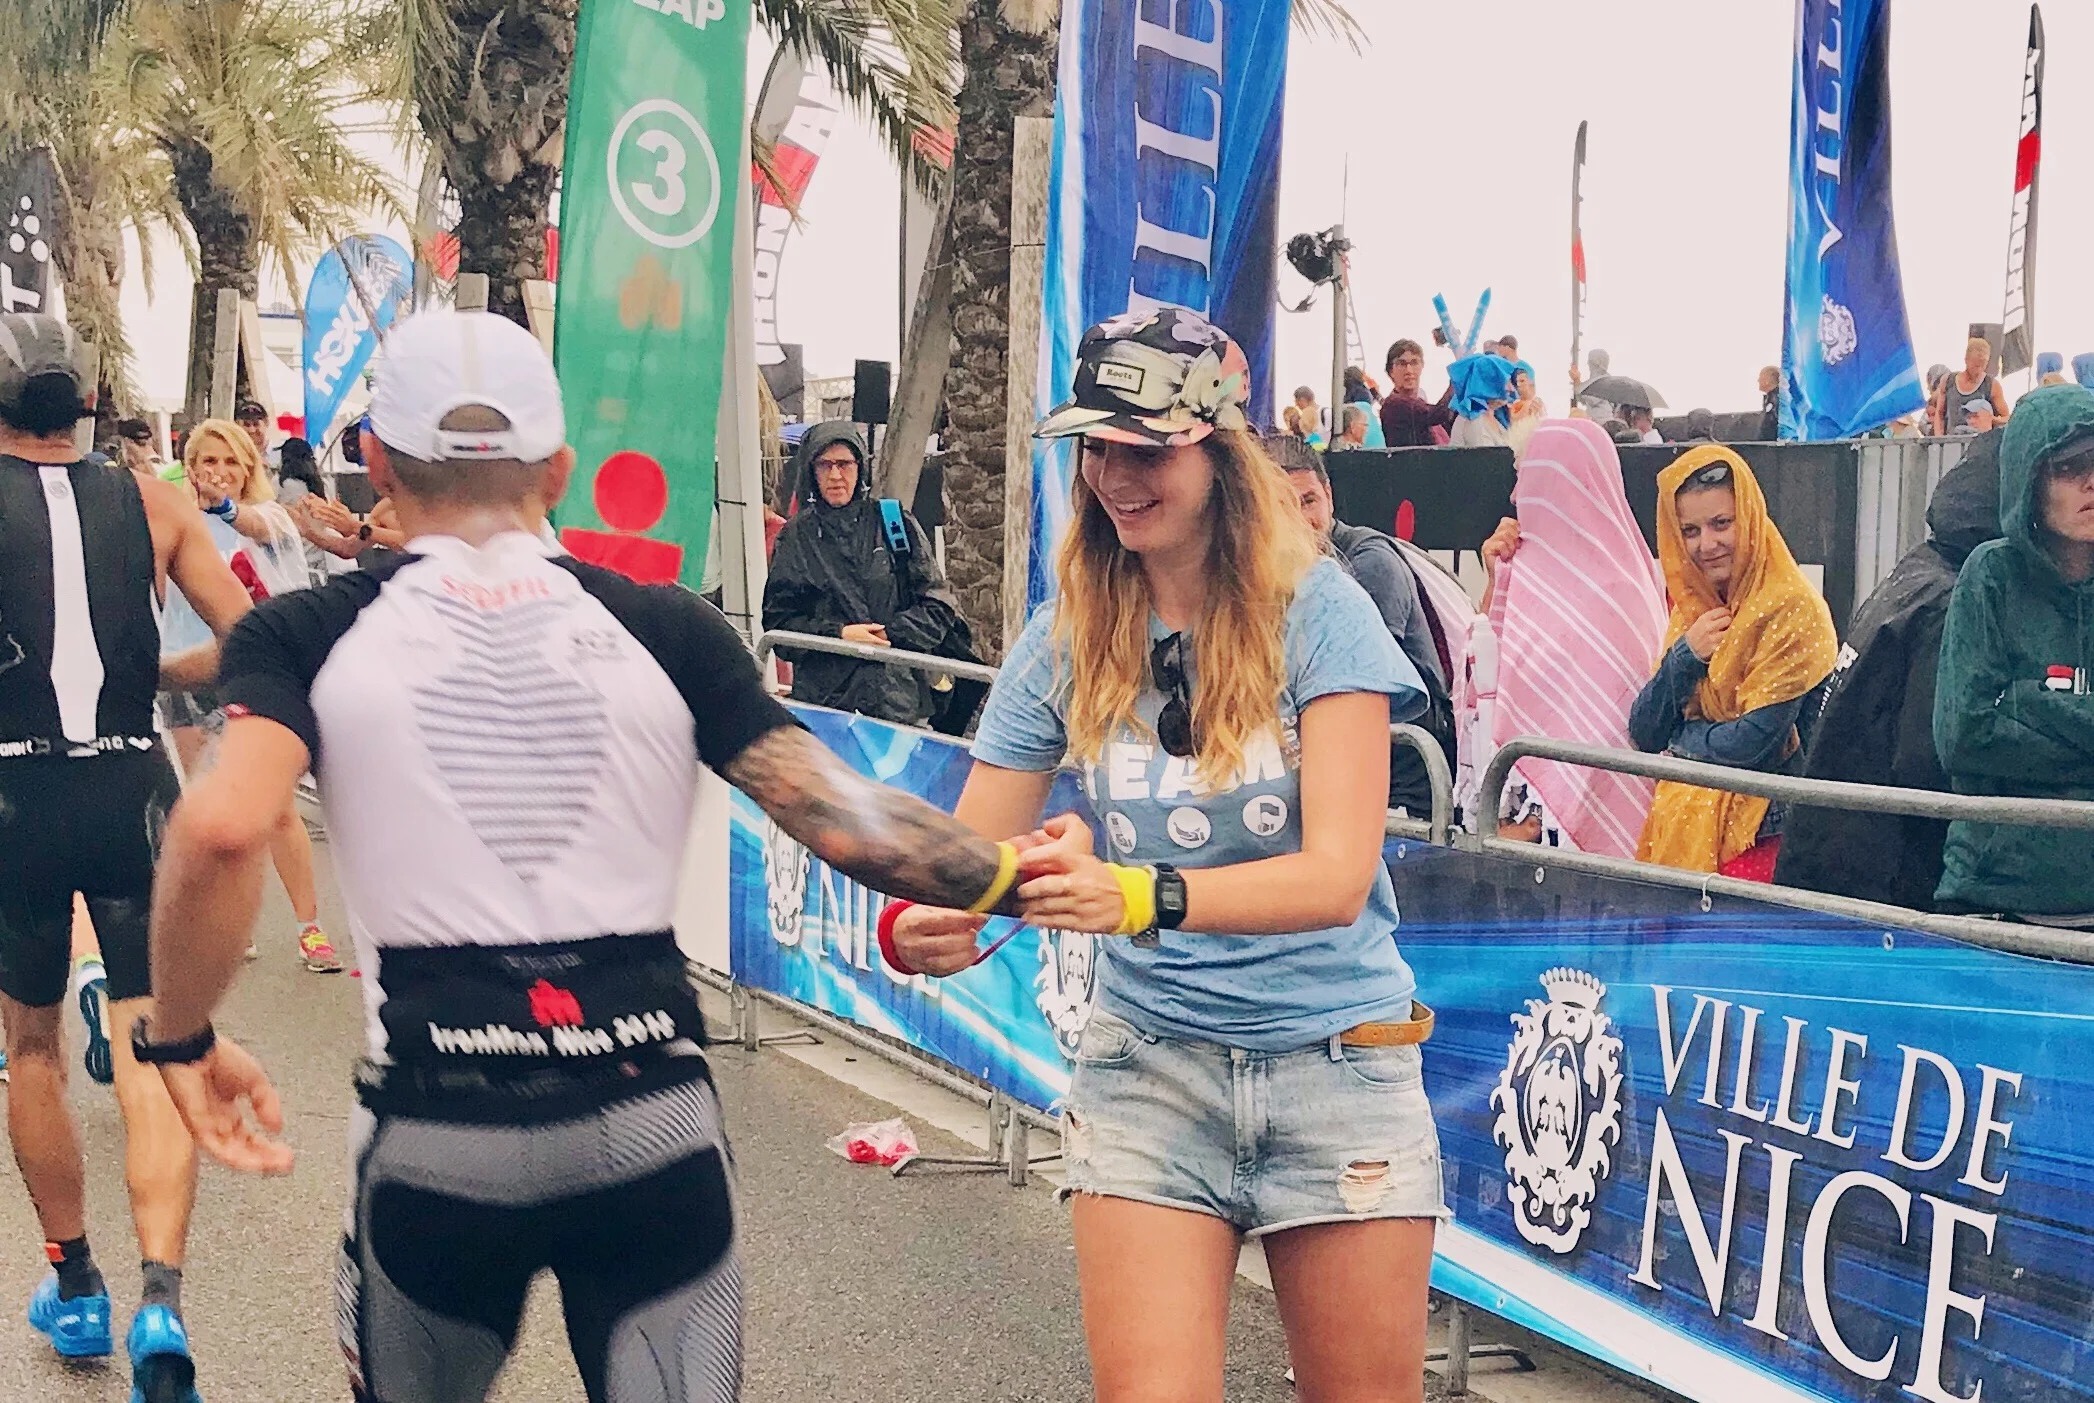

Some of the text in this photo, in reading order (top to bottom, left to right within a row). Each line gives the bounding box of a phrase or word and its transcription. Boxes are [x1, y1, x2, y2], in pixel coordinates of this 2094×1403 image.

[632, 0, 726, 31] AP
[631, 129, 687, 217] 3
[1814, 0, 1844, 265] VILL
[1106, 367, 1133, 381] Roots
[2045, 664, 2092, 696] FIL
[1650, 984, 2023, 1196] VILLE DE
[1627, 1106, 1998, 1403] NICE
